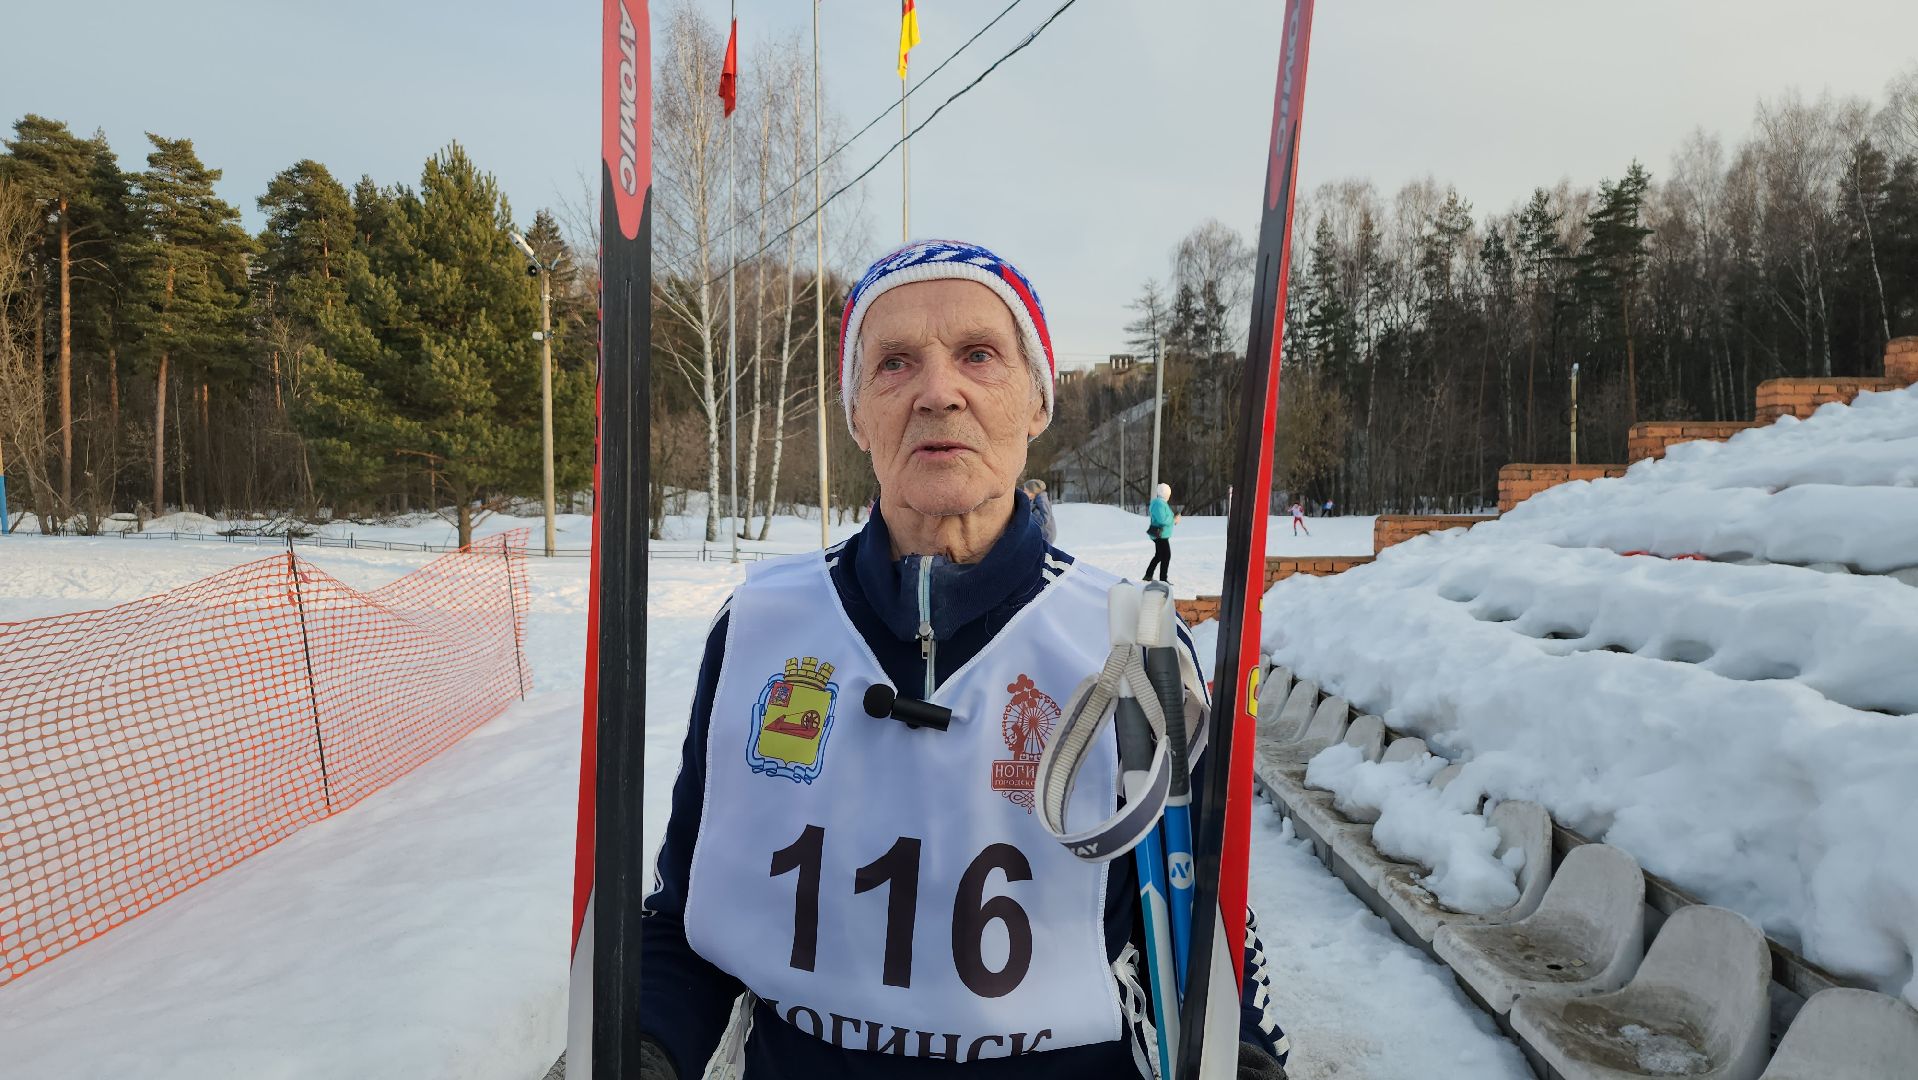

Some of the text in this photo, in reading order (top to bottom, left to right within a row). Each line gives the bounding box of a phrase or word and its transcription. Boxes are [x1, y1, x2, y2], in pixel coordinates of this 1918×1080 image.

[619, 0, 637, 196] ATOMIC
[1276, 0, 1300, 158] OMIC
[770, 824, 1033, 998] 116
[763, 998, 1052, 1062] ОГИНСК
